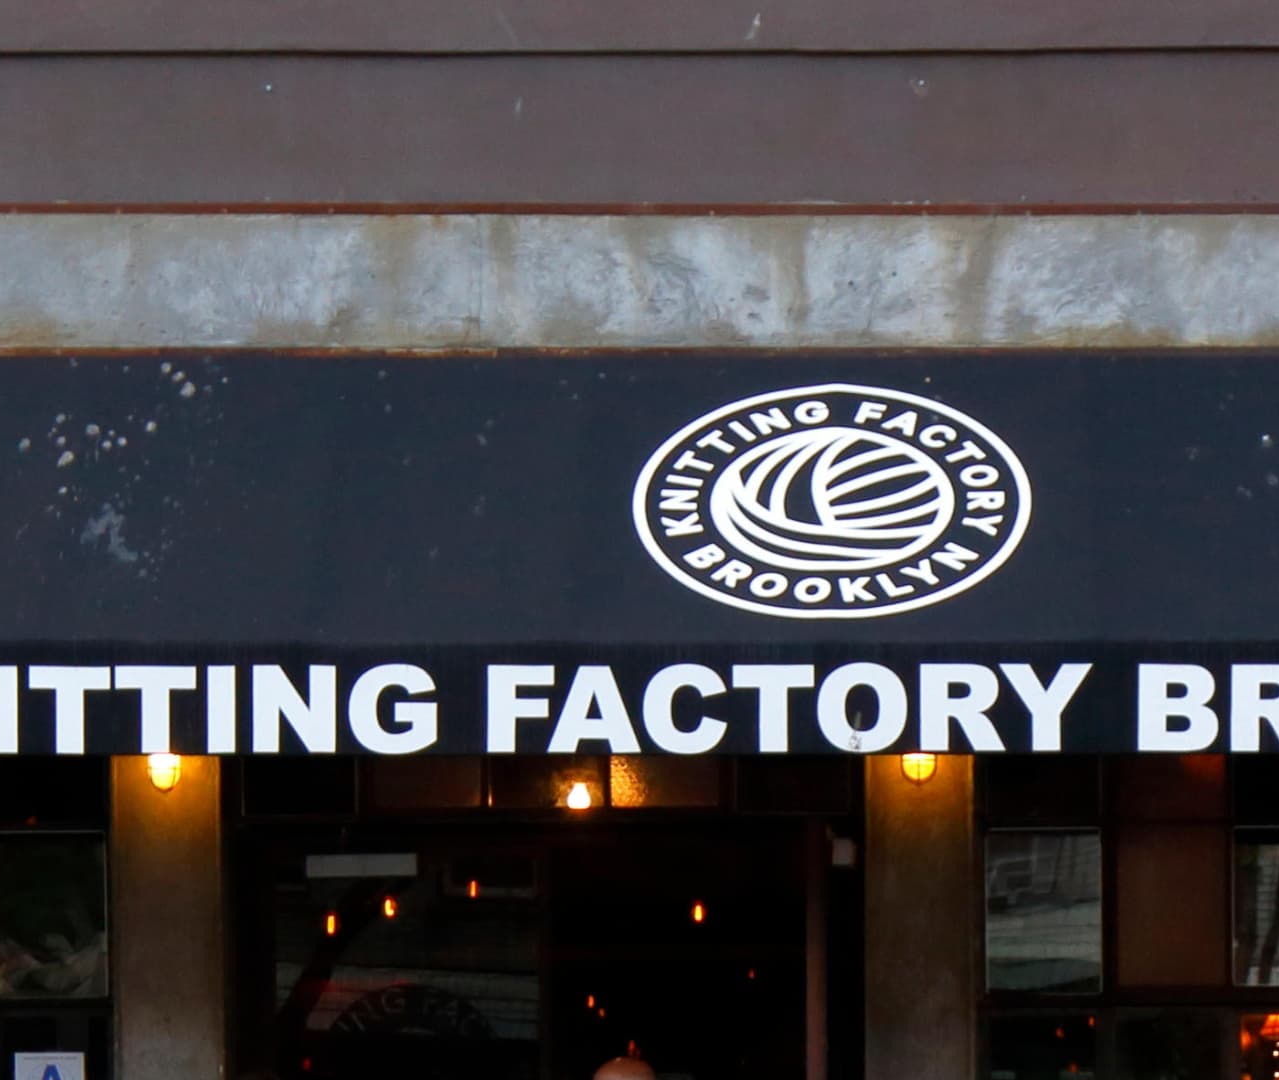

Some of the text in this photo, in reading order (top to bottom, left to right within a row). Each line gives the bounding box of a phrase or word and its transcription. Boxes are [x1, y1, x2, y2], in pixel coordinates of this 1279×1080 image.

[659, 398, 1007, 538] KNITTING FACTORY
[681, 541, 981, 605] BROOKLYN
[485, 661, 1095, 755] FACTORY
